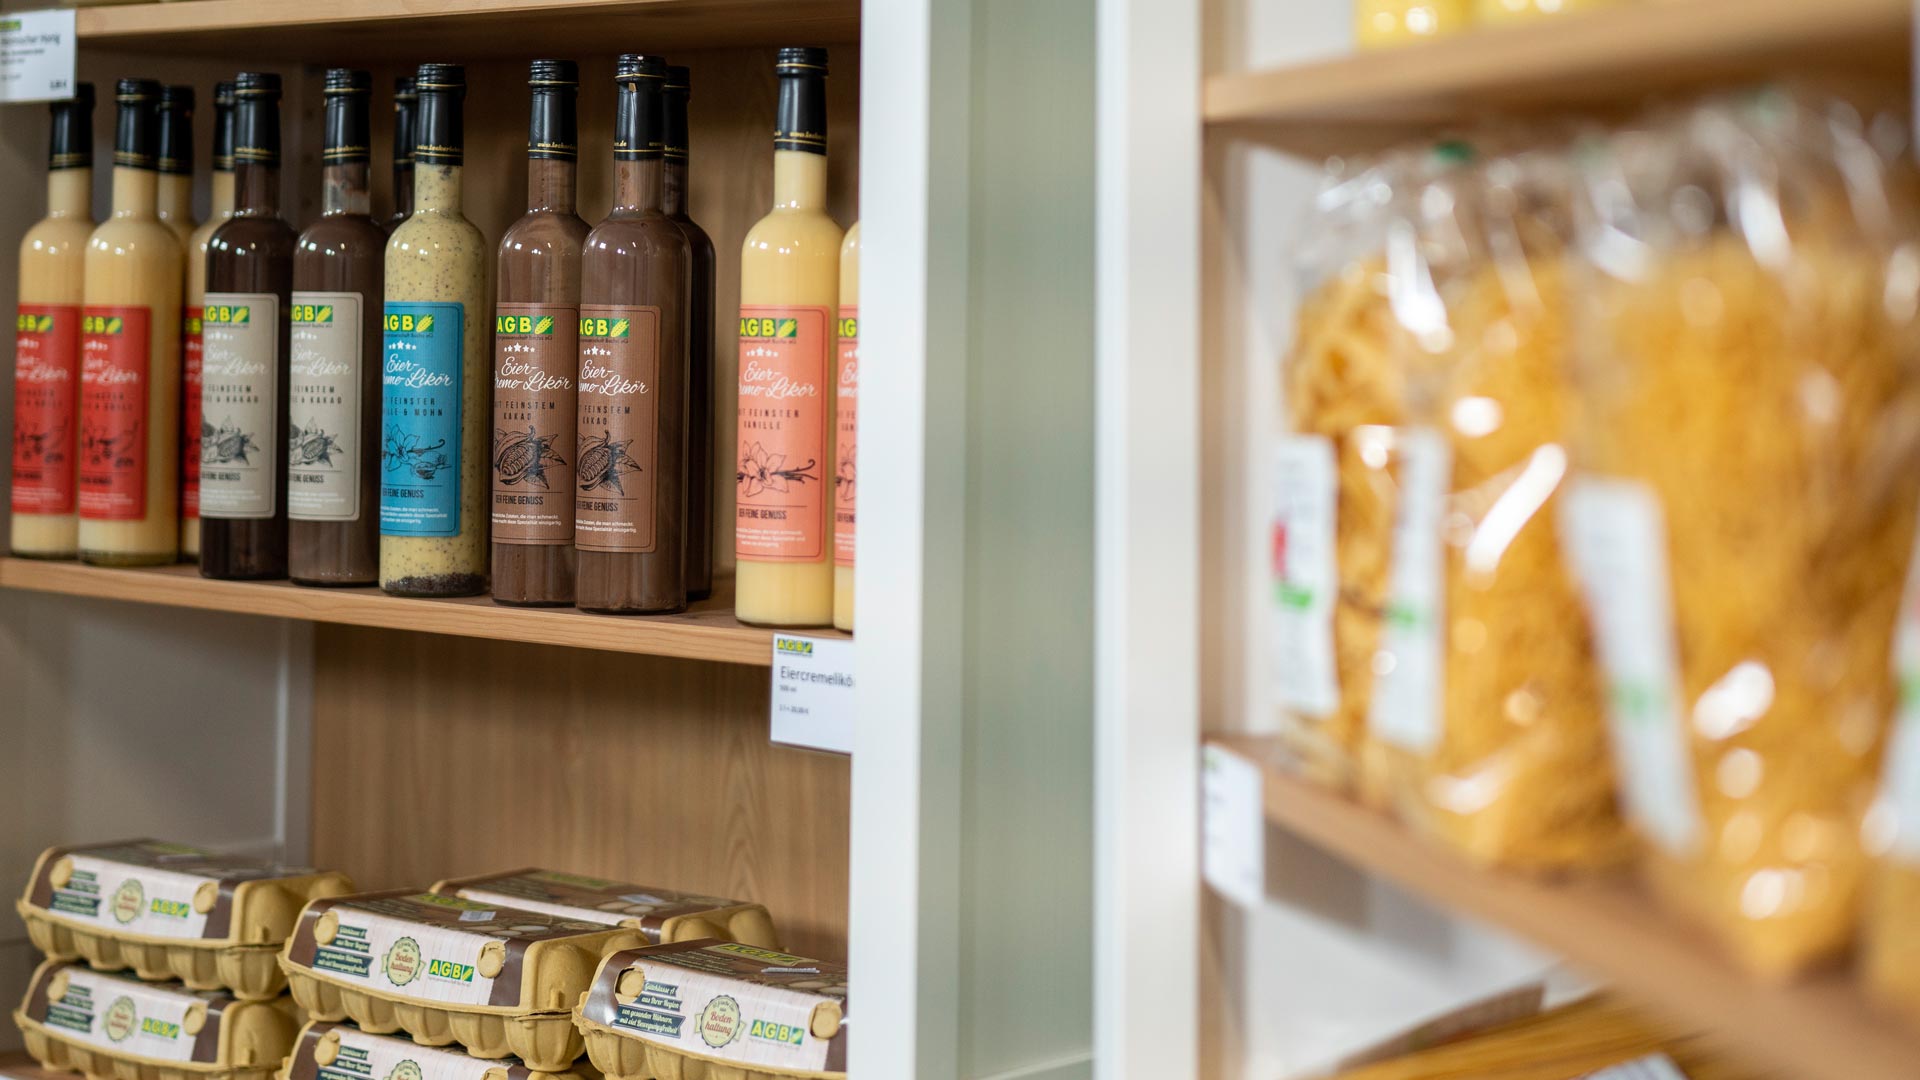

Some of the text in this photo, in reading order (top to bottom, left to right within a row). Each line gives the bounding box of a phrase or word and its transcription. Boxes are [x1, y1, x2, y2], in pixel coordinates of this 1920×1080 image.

[497, 316, 532, 334] AGB
[387, 353, 421, 373] Eier-
[501, 356, 539, 376] Eier-
[582, 359, 615, 380] Eier-
[744, 361, 784, 382] Eier-
[415, 408, 443, 416] MOHN
[506, 401, 555, 410] FEINSTEM
[504, 412, 532, 421] KAKAO
[401, 489, 425, 499] GENUSS
[503, 495, 517, 505] FEINE
[518, 496, 544, 506] GENUSS
[594, 501, 619, 512] GENUSS
[760, 510, 787, 520] GENUSS
[781, 665, 854, 687] Eiercremelikö
[430, 960, 463, 979] AGB
[711, 1011, 734, 1024] Boden-
[705, 1021, 733, 1037] haltung
[751, 1019, 790, 1042] AGB
